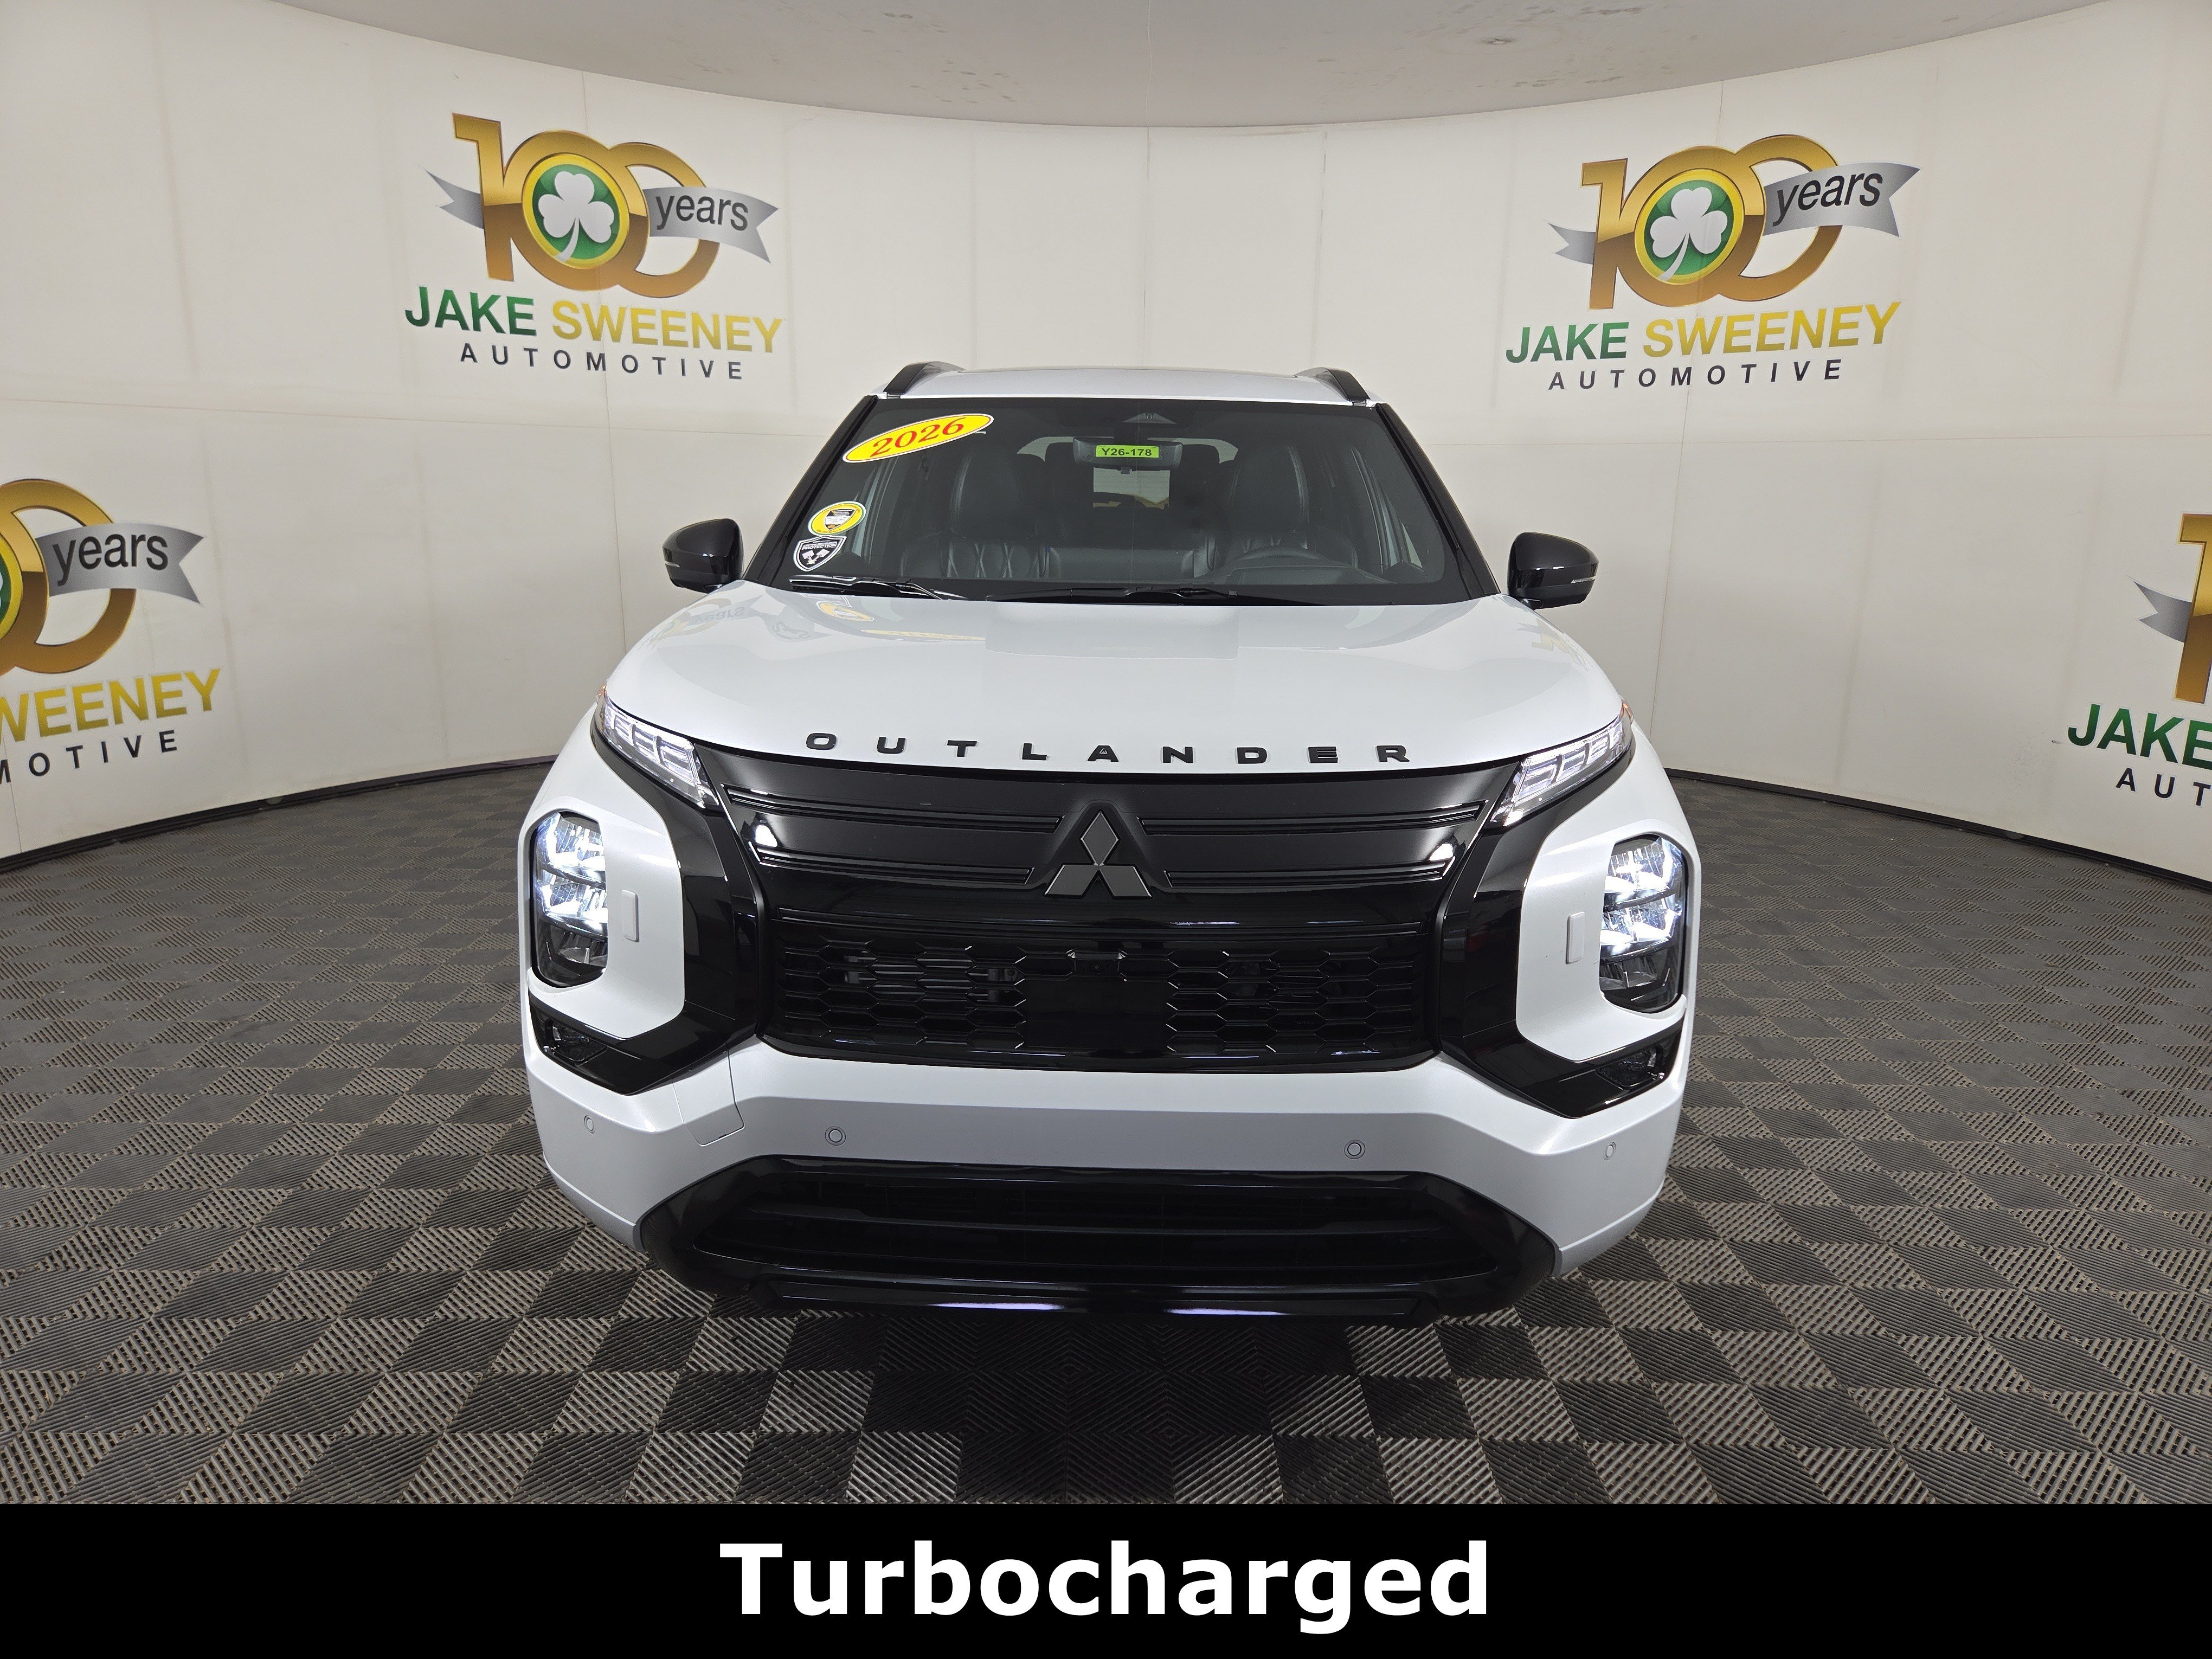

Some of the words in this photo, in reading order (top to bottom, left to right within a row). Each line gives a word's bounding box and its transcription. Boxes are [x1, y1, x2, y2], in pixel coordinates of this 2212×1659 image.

[655, 194, 749, 231] years
[1772, 171, 1883, 227] years
[404, 285, 537, 337] JAKE
[552, 300, 784, 353] SWEENEY
[1506, 321, 1630, 363] JAKE
[1642, 301, 1902, 358] SWEENEY
[460, 342, 743, 380] AUTOMOTIVE
[1548, 358, 1842, 390] AUTOMOTIVE
[870, 417, 966, 458] 2026
[1101, 448, 1152, 456] Y26-178
[53, 533, 169, 587] years
[805, 732, 1410, 763] OUTLANDER
[2067, 703, 2212, 770] JAKE
